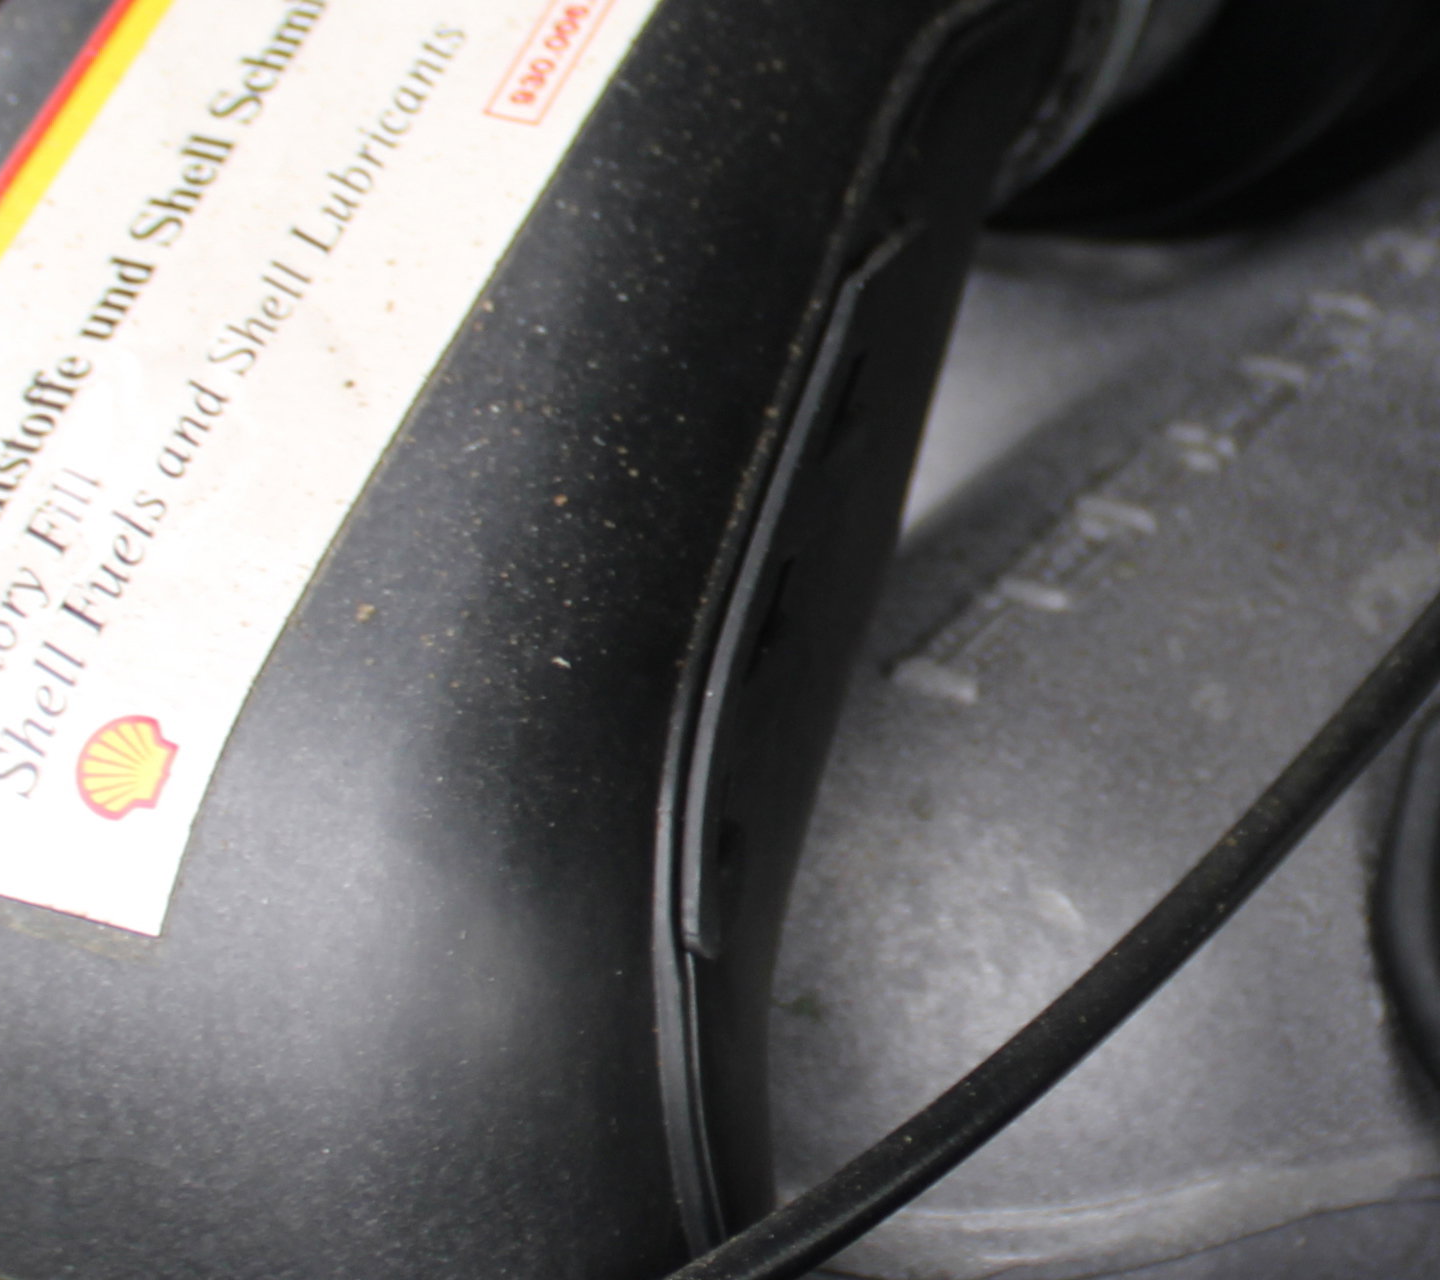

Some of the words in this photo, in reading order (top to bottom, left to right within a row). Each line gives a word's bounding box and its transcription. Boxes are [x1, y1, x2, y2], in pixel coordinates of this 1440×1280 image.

[60, 484, 170, 636] Fuels
[161, 378, 230, 482] and
[207, 261, 313, 377] Shell
[290, 24, 467, 255] Lubricants
[80, 256, 157, 342] und
[129, 134, 237, 248] Shell
[25, 468, 102, 555] Fill
